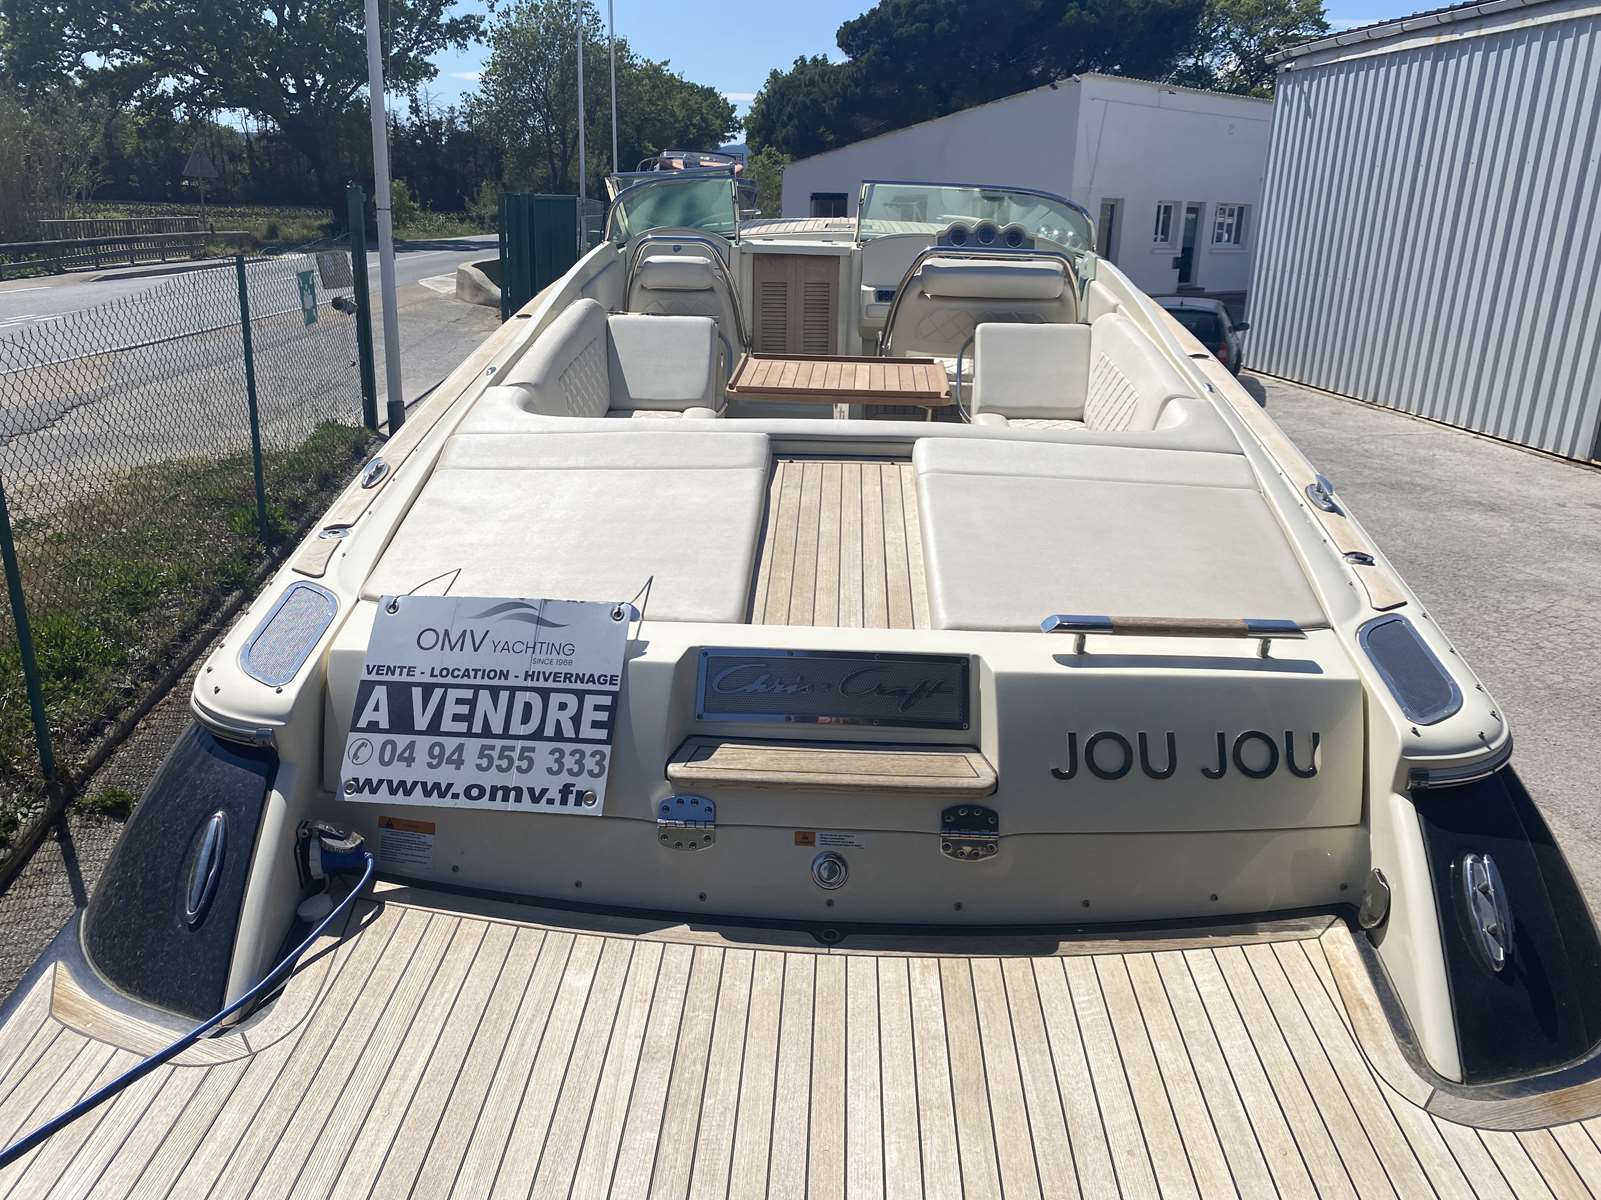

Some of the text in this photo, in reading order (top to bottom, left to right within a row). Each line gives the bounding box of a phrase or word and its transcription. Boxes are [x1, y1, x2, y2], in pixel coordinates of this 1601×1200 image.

[416, 627, 576, 657] OMV YACHTING
[366, 664, 417, 677] VENTE
[429, 667, 510, 681] LOCATION
[523, 670, 620, 686] HIVERNAGE
[532, 656, 553, 666] SINCE
[356, 685, 613, 740] A VENDRE
[378, 739, 607, 779] 04 94 555 333
[1050, 730, 1321, 781] JOU JOU
[351, 777, 588, 807] www.omv.fr
